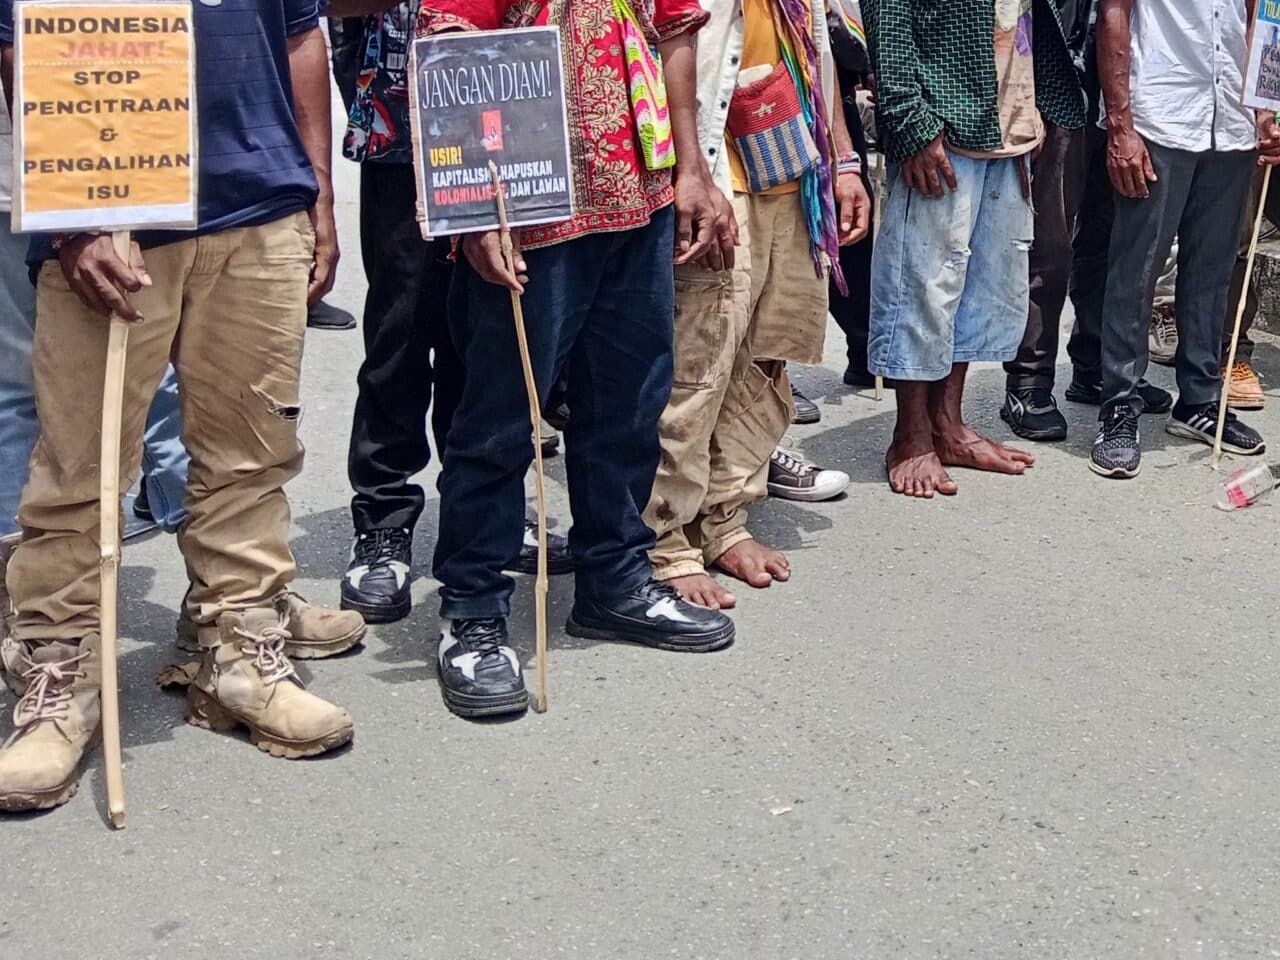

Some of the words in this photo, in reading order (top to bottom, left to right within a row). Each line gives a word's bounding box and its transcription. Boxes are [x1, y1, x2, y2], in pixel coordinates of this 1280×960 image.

[24, 17, 189, 35] INDONESIA
[60, 40, 167, 59] JAHAT!
[74, 70, 141, 86] STOP
[422, 67, 496, 109] JANGAN
[499, 60, 553, 102] DIAM!
[24, 98, 189, 115] PENCITRAAN
[99, 128, 119, 143] &
[24, 154, 190, 175] PENGALIHAN
[430, 146, 463, 167] USIR!
[87, 185, 130, 200] ISU
[510, 181, 532, 198] DAN
[533, 177, 566, 195] LAWAN
